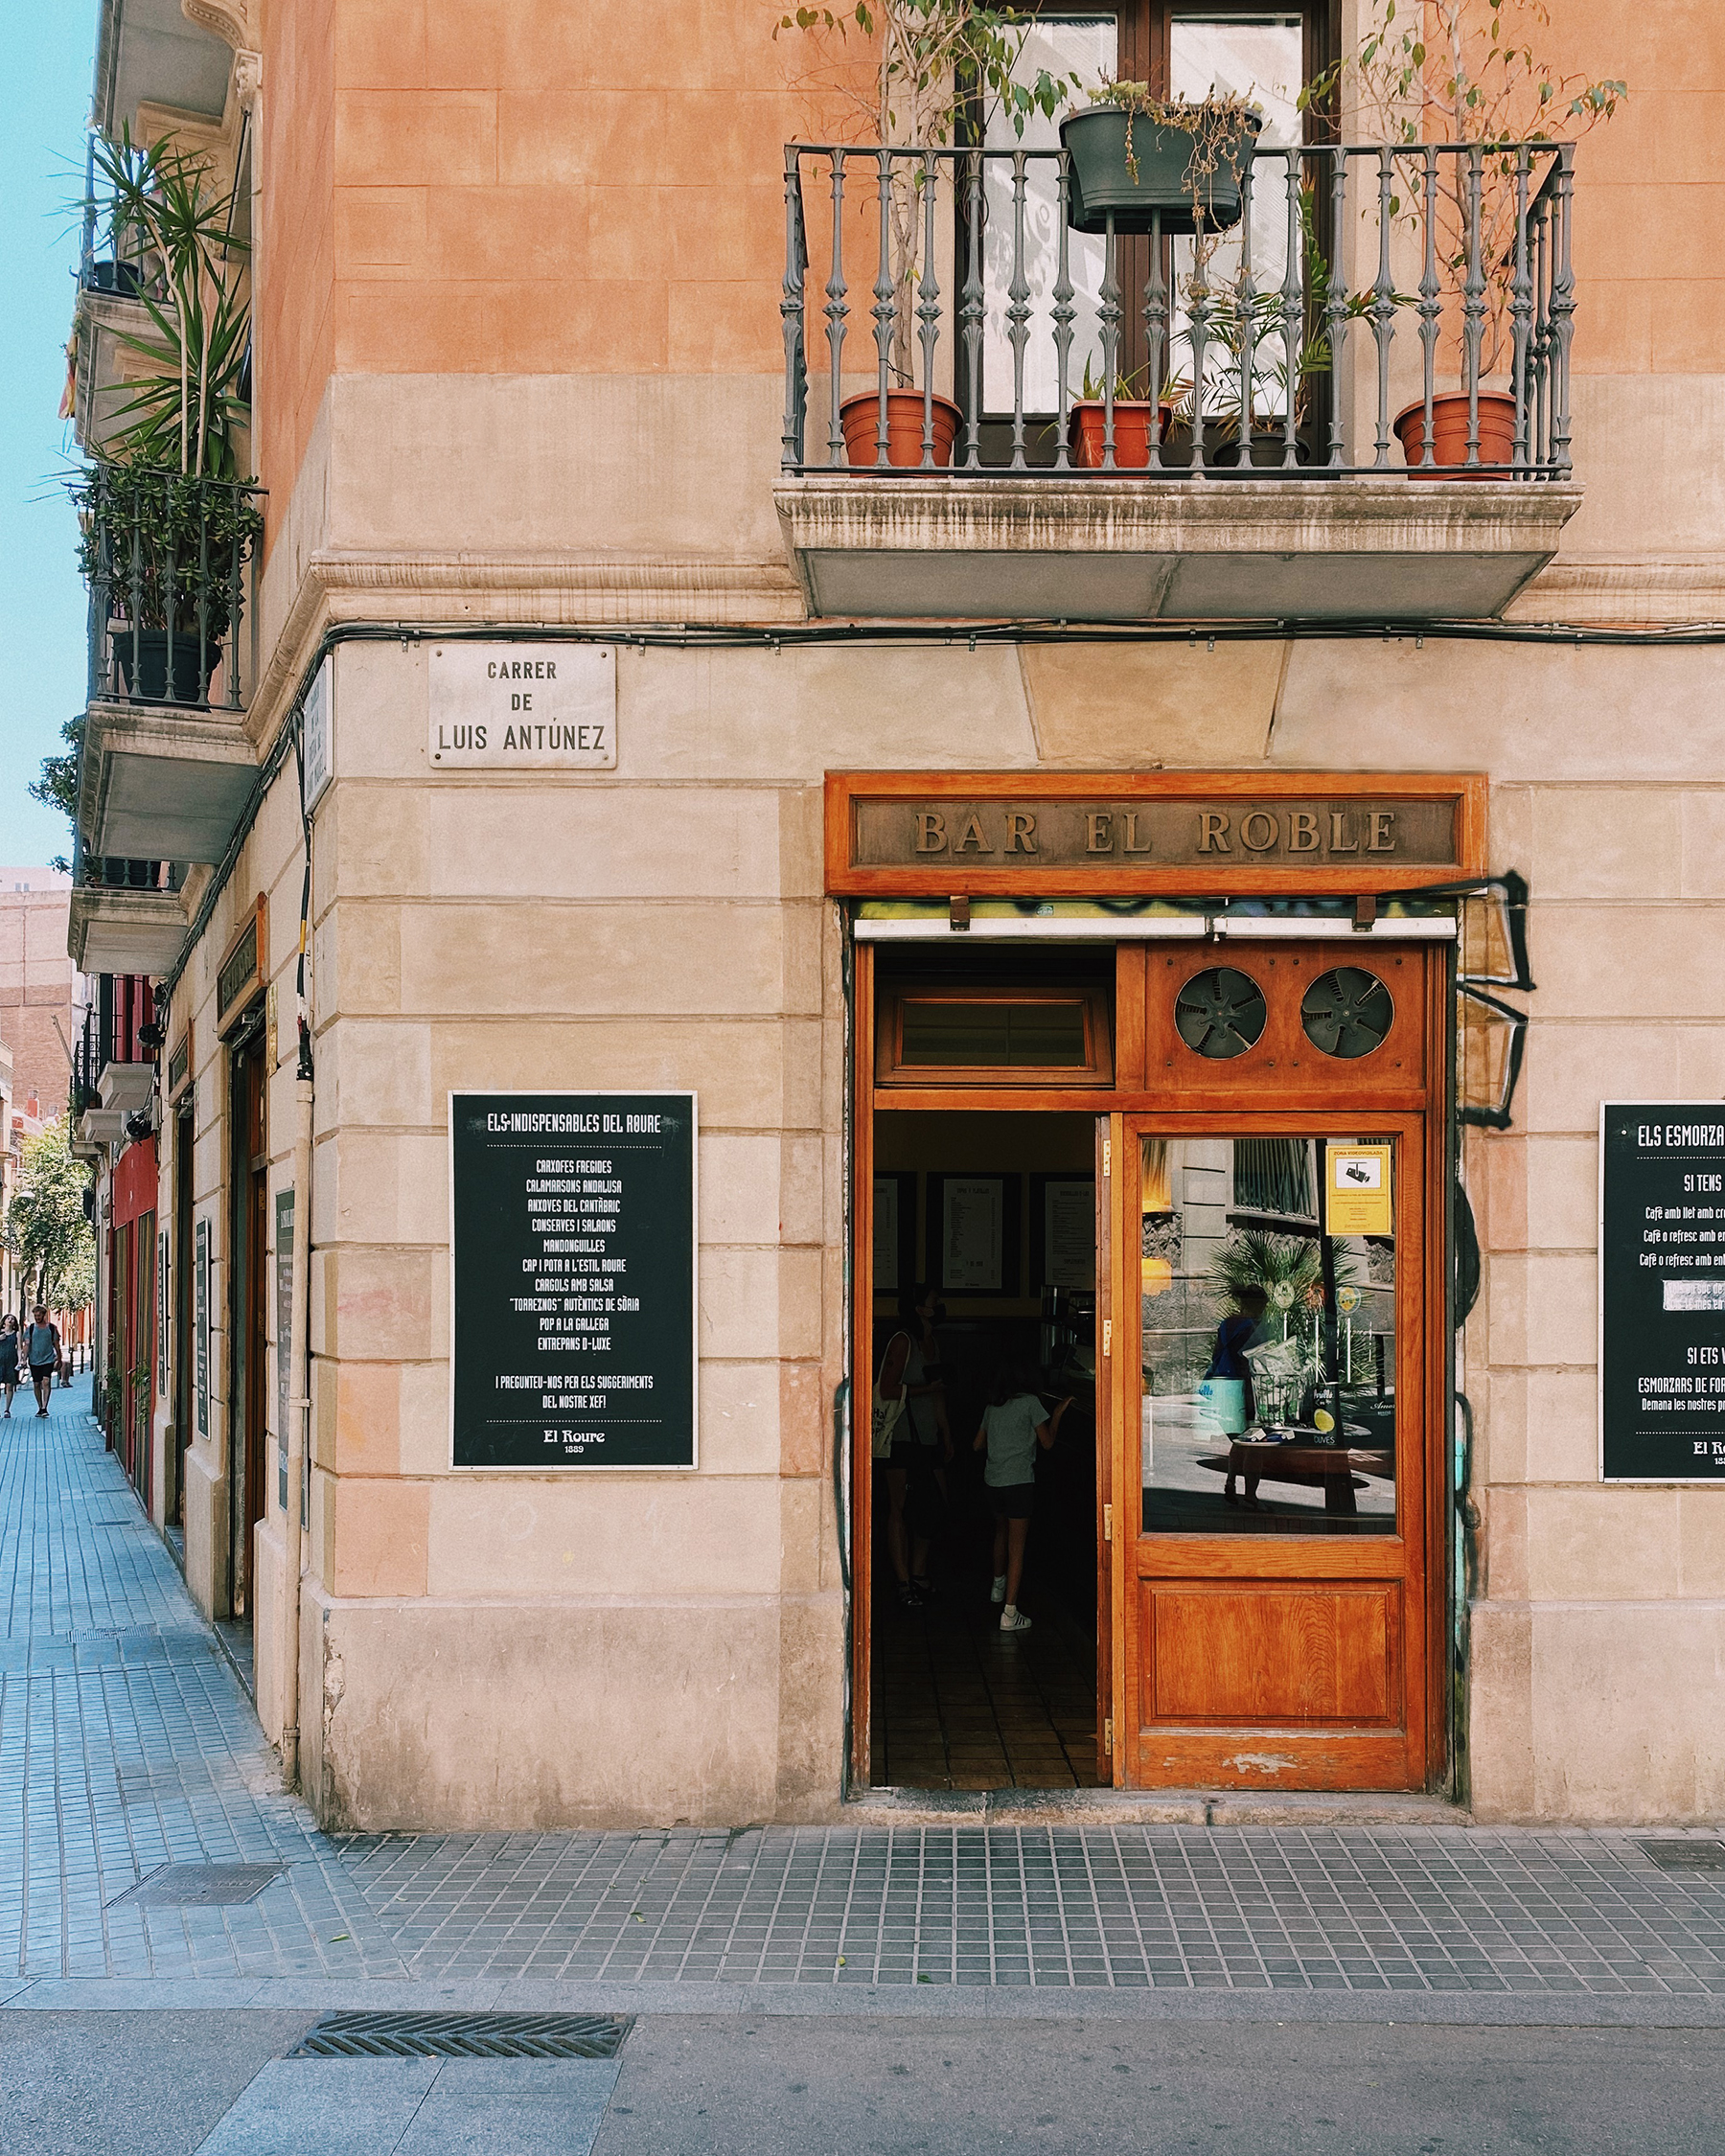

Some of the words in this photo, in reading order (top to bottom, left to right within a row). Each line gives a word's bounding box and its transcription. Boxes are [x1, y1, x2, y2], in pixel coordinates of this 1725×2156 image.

[488, 661, 557, 679] CARRER
[511, 694, 532, 711] DE
[439, 724, 488, 750] LUIS
[503, 718, 605, 750] ANTÚNEZ
[914, 811, 1038, 854] BAR
[1085, 812, 1152, 854] EL
[1198, 811, 1396, 853] ROBLE
[488, 1113, 509, 1131] ELS
[510, 1113, 599, 1132] INDISPENSABLES
[604, 1114, 623, 1133] DEL
[627, 1114, 660, 1133] ROURE
[1639, 1125, 1661, 1146] ELS
[537, 1159, 574, 1173] CARXOFES
[576, 1160, 611, 1173] FREGIDES
[526, 1180, 581, 1193] CALAMARSONS
[583, 1180, 621, 1193] ANDALUSA
[1685, 1175, 1693, 1191] SI
[1697, 1175, 1721, 1191] TENS
[528, 1199, 562, 1212] ANXOVES
[564, 1200, 578, 1212] DEL
[580, 1197, 620, 1212] CANTÀBRIC
[1665, 1206, 1681, 1219] amb
[1683, 1206, 1695, 1219] llet
[1697, 1206, 1714, 1218] amb
[532, 1219, 575, 1231] CONSERVES
[577, 1219, 580, 1231] I
[1663, 1232, 1668, 1242] o
[1669, 1229, 1697, 1244] refresc
[1699, 1229, 1715, 1241] amb
[543, 1239, 605, 1252] MANDONGUILLES
[523, 1259, 537, 1272] CAP
[540, 1259, 541, 1272] I
[544, 1259, 563, 1272] POTA
[564, 1259, 569, 1272] A
[602, 1259, 626, 1272] ROURE
[1659, 1256, 1664, 1266] o
[1666, 1253, 1693, 1268] refresc
[1695, 1253, 1712, 1266] amb
[536, 1278, 568, 1292] CARGOLS
[571, 1278, 586, 1292] AMB
[589, 1278, 613, 1292] SALSA
[606, 1298, 615, 1311] DE
[540, 1318, 554, 1330] POP
[557, 1318, 562, 1330] A
[564, 1318, 573, 1331] LA
[576, 1318, 609, 1330] GALLEGA
[539, 1338, 580, 1350] ENTREPANS
[583, 1338, 610, 1350] D-LUXE
[1688, 1347, 1697, 1364] SI
[1701, 1347, 1718, 1364] ETS
[495, 1376, 498, 1388] I
[501, 1376, 562, 1388] PREGUNTEU-NOS
[564, 1376, 579, 1388] PER
[581, 1376, 595, 1388] ELS
[597, 1376, 653, 1388] SUGGERIMENTS
[1639, 1378, 1692, 1392] ESMORZARS
[1695, 1378, 1707, 1392] DE
[542, 1395, 557, 1409] DEL
[560, 1395, 587, 1409] NOSTRE
[589, 1395, 606, 1409] XEF!
[1643, 1398, 1672, 1411] Demana
[1674, 1398, 1686, 1411] les
[1688, 1398, 1715, 1411] nostres
[543, 1431, 558, 1442] El
[562, 1431, 605, 1442] Roure
[1693, 1442, 1708, 1454] El
[1712, 1442, 1725, 1454] R
